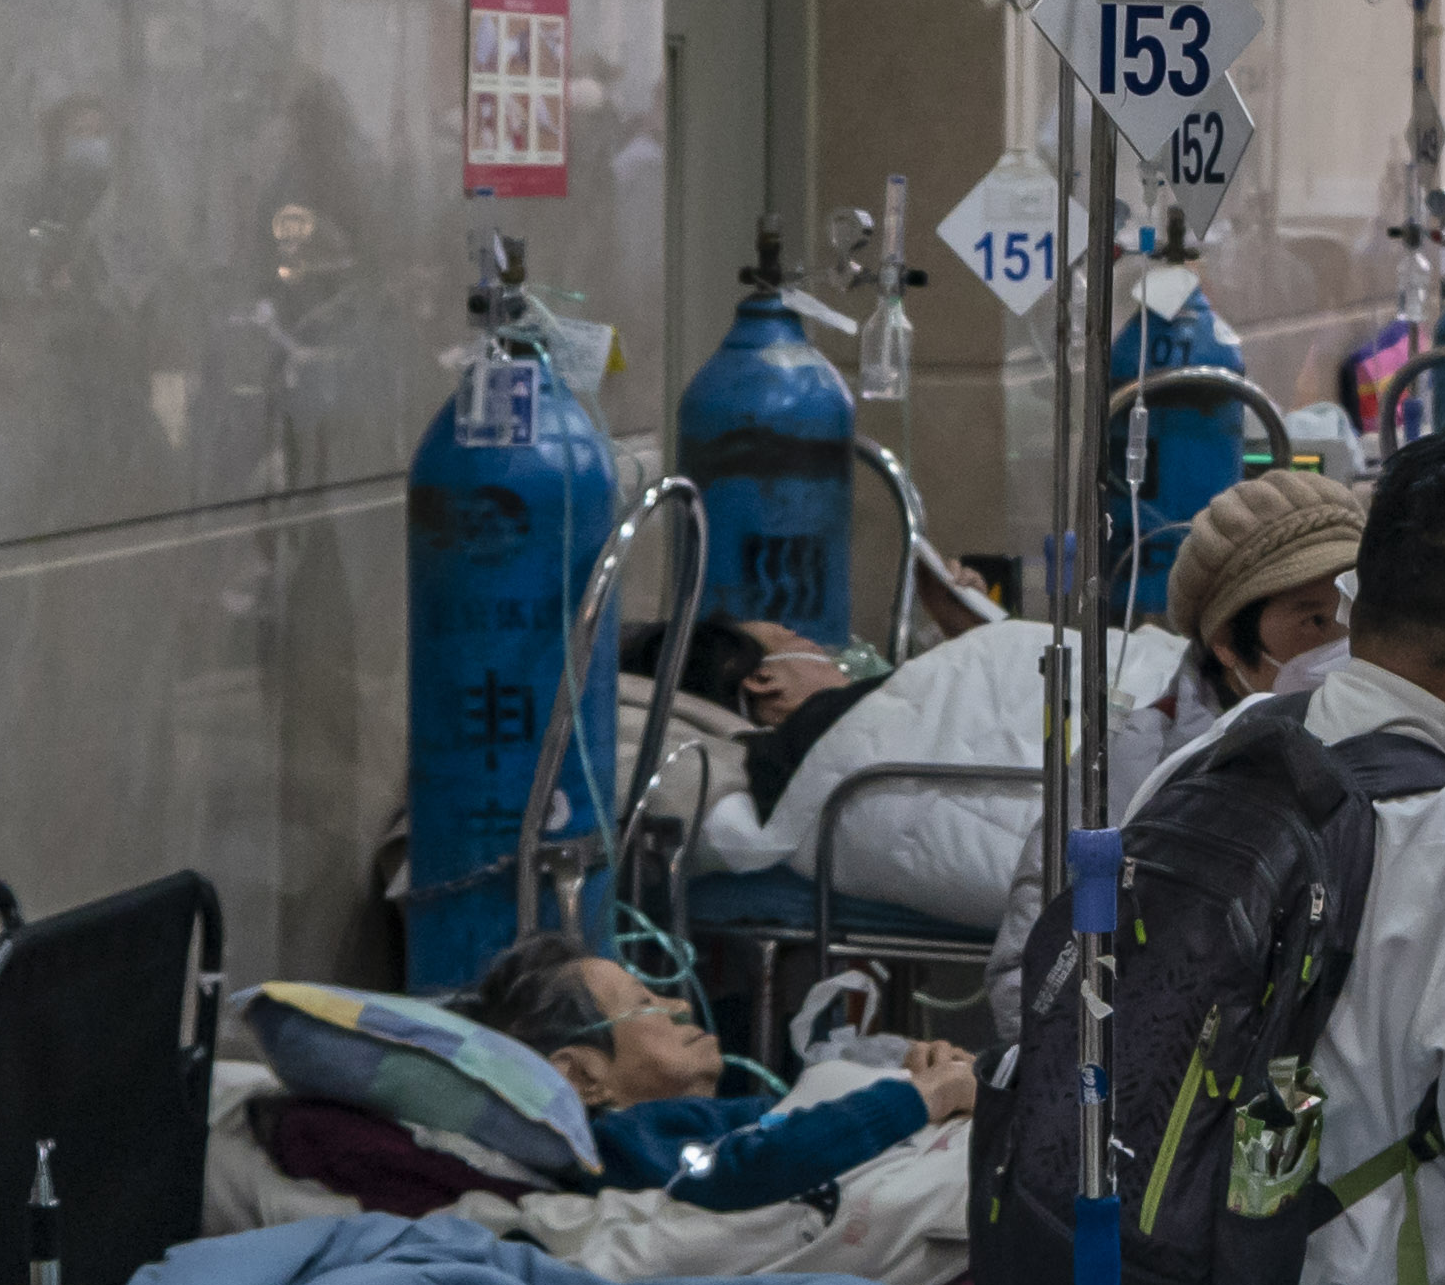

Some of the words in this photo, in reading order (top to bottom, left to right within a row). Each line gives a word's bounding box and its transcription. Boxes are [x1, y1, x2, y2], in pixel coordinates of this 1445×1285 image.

[1099, 3, 1212, 97] 153
[1171, 112, 1226, 186] 152
[974, 230, 1056, 284] 151
